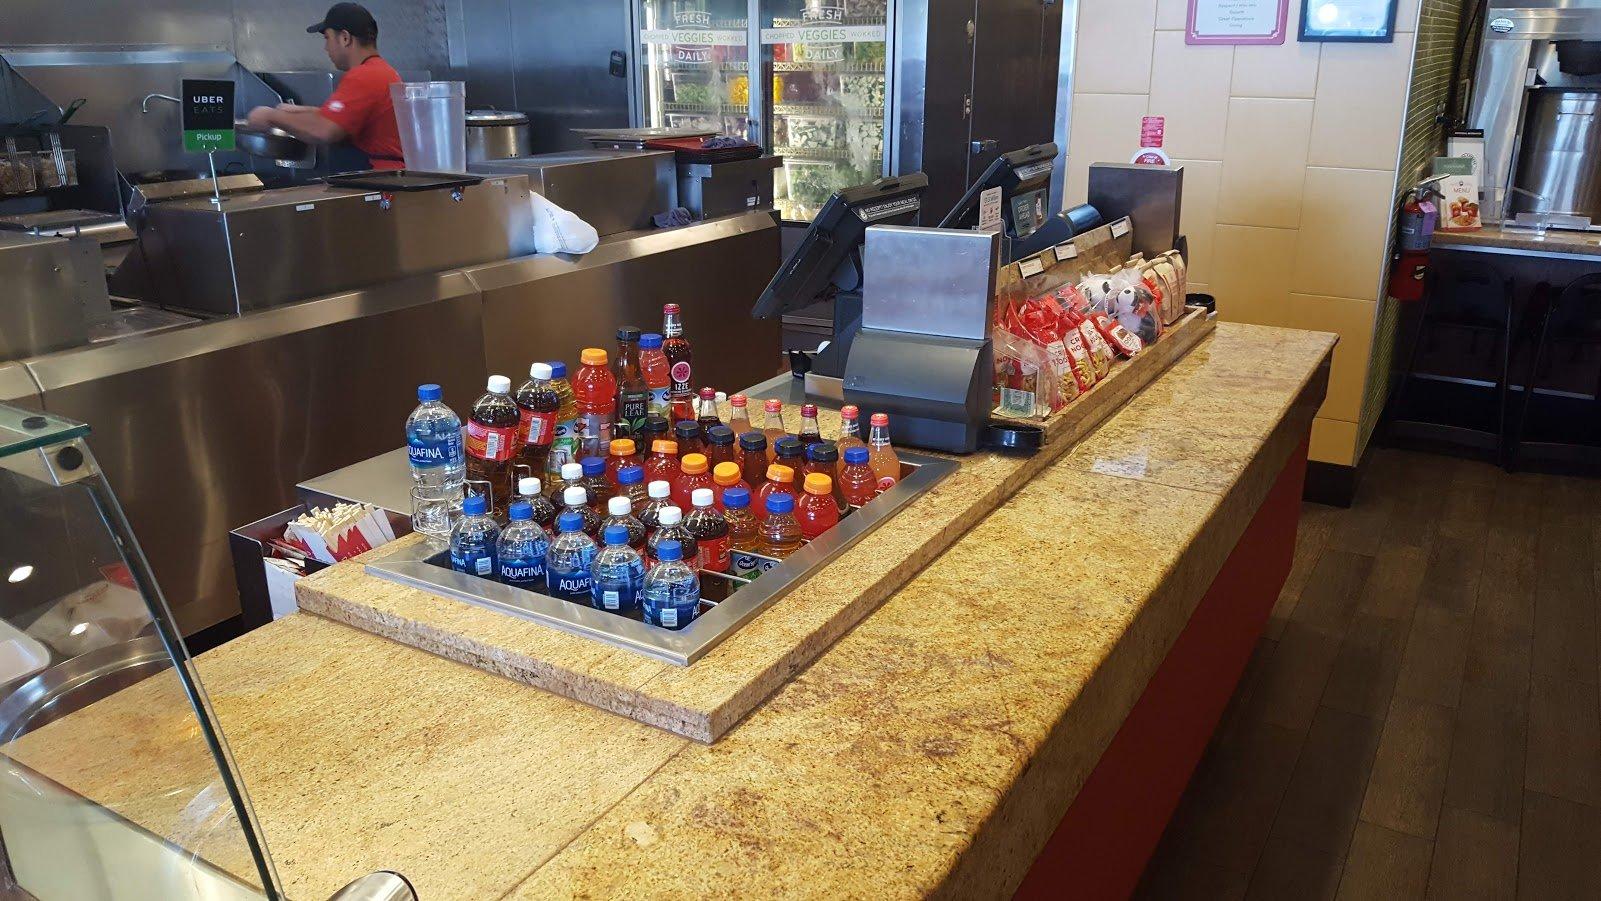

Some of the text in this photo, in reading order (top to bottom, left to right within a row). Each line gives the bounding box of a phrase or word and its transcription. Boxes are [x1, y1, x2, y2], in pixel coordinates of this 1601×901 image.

[675, 13, 710, 25] FRESH
[802, 9, 842, 21] FRESH
[671, 32, 714, 43] VEGGIES
[798, 29, 847, 41] VEGGIES
[678, 50, 708, 61] DAILY
[805, 48, 839, 59] DAILY
[193, 95, 224, 103] UBER
[193, 106, 224, 114] EATS
[196, 132, 222, 141] Pickup
[1453, 186, 1471, 194] MENU
[674, 382, 689, 391] IZZE
[625, 403, 645, 411] PURE
[408, 445, 445, 459] QUAFINA
[501, 563, 545, 579] AQUAFINA
[559, 577, 592, 592] AQUAFI
